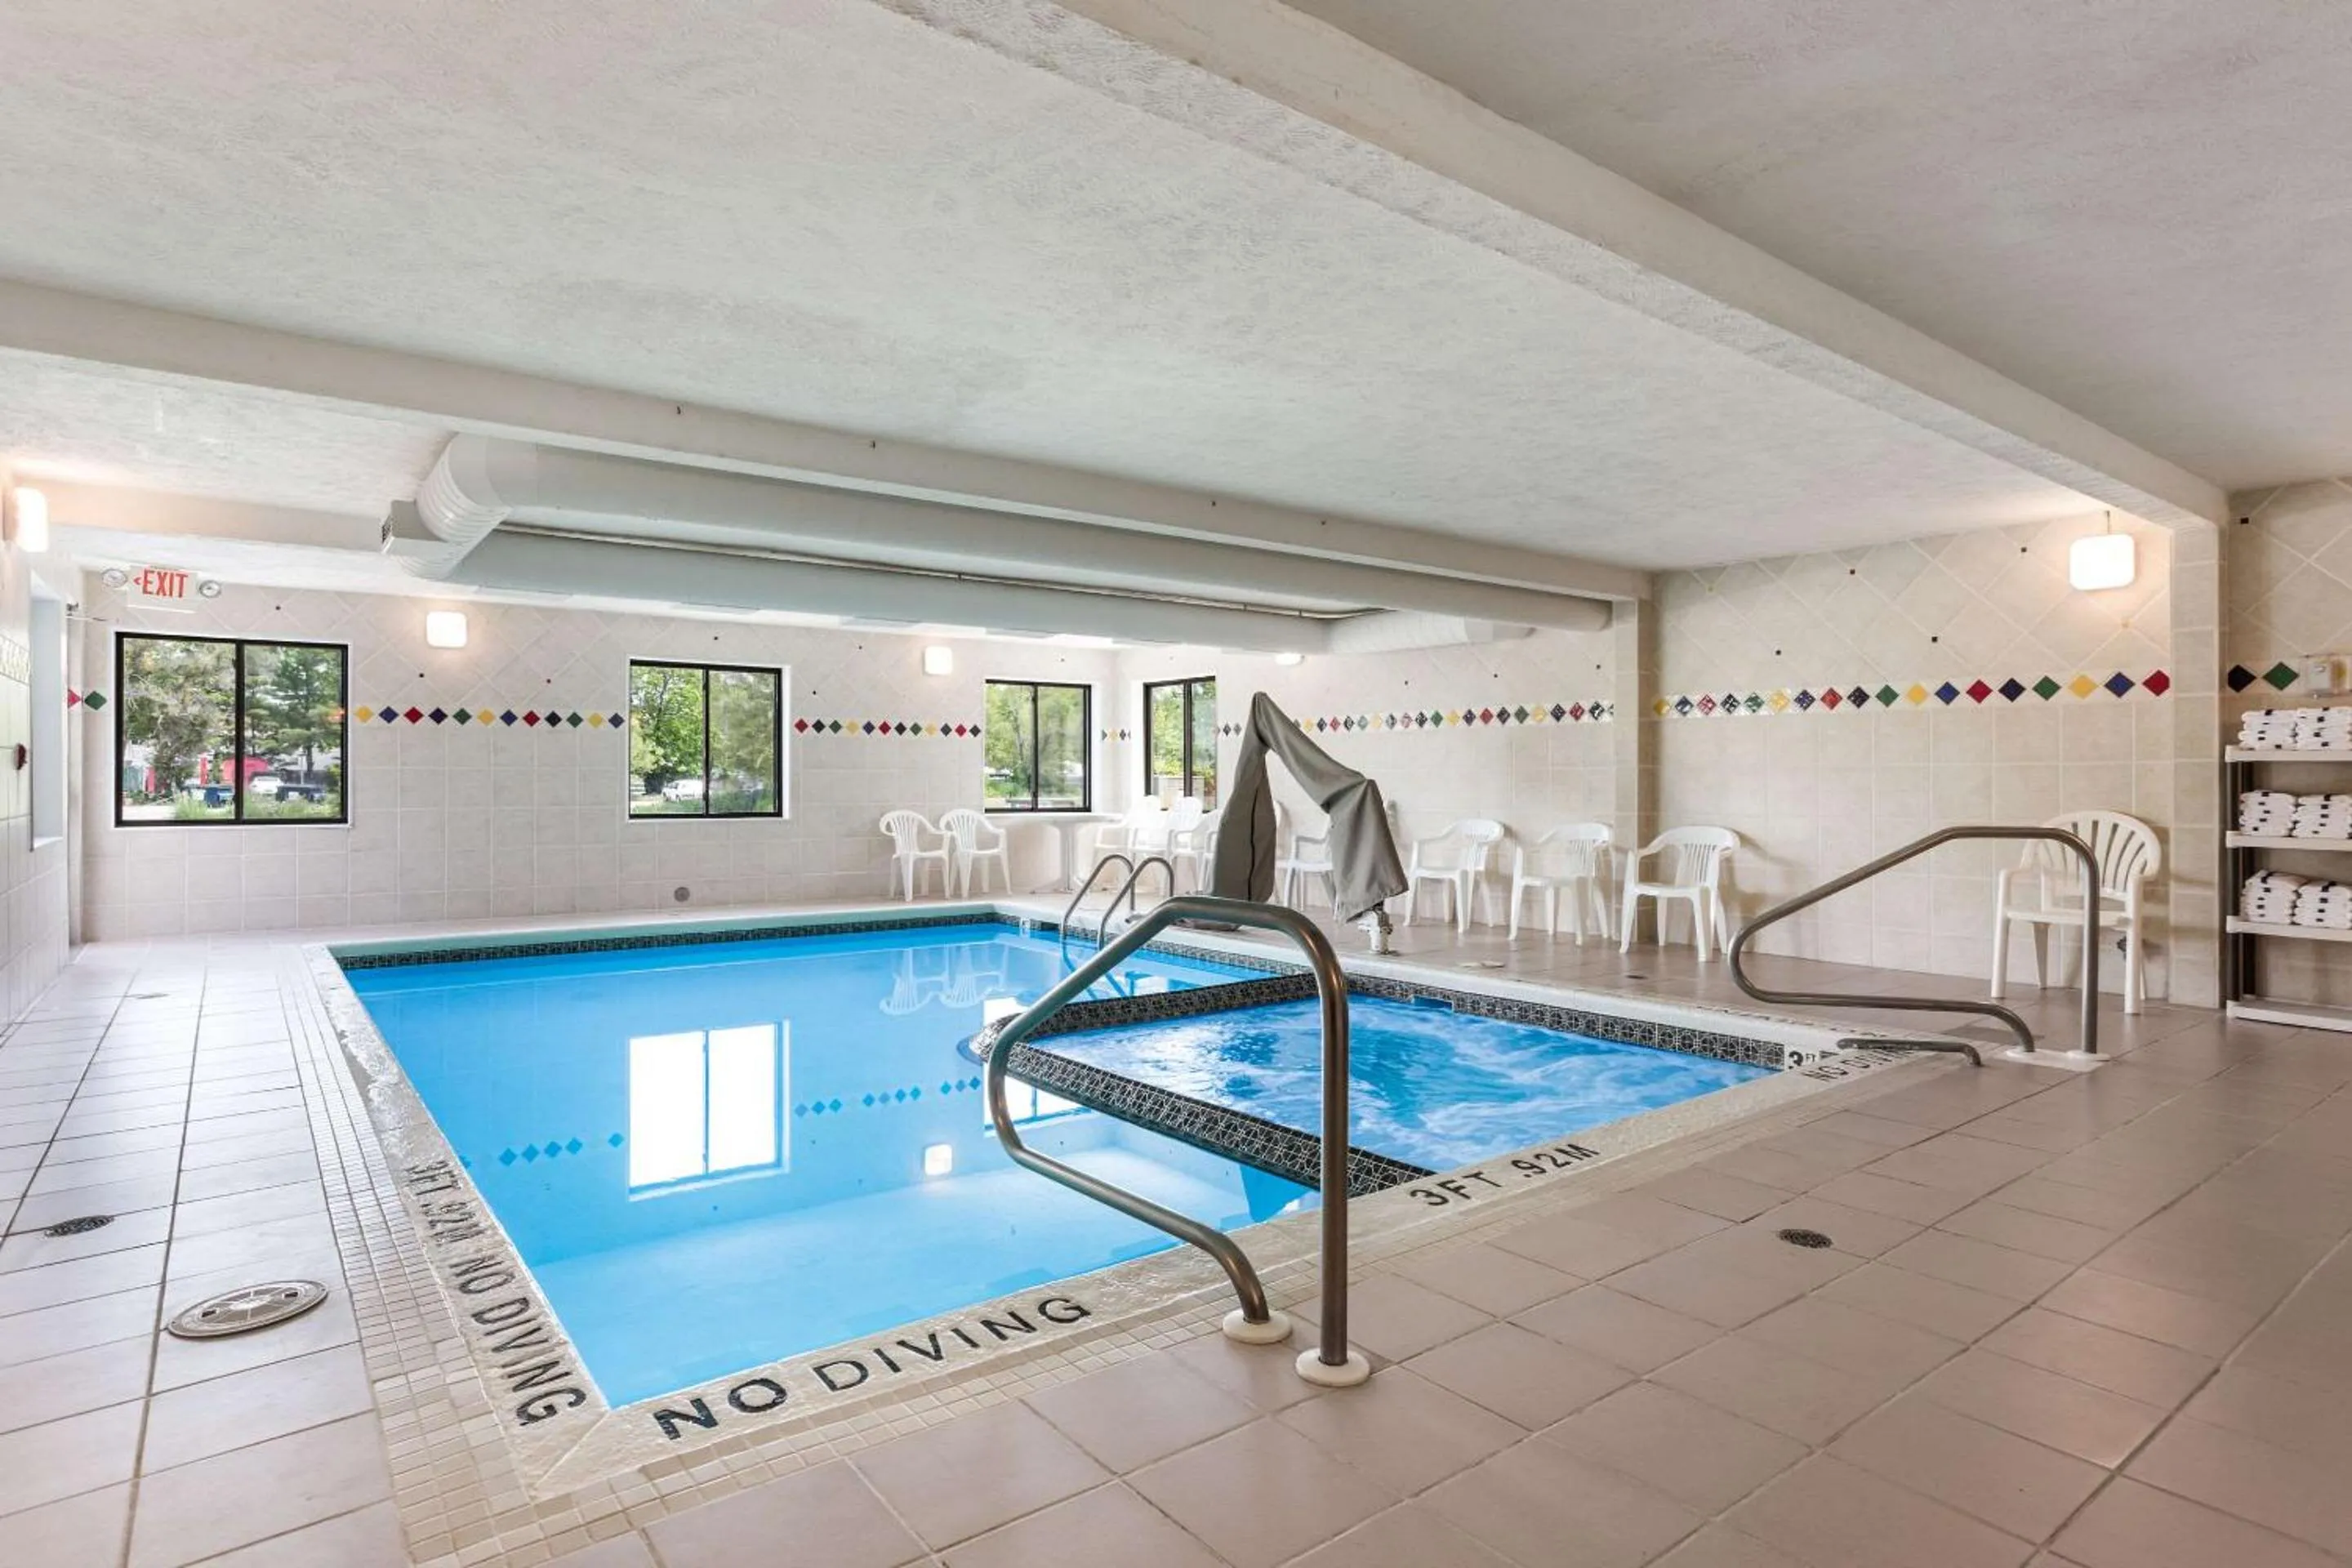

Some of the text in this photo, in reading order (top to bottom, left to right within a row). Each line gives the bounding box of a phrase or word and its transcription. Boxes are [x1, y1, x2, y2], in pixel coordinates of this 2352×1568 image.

[142, 568, 189, 598] EXIT
[1802, 1065, 1849, 1083] NO
[1410, 1143, 1600, 1206] 3FT .92M
[449, 1254, 515, 1294] NO
[471, 1297, 587, 1427] DIVING
[653, 1297, 1092, 1441] NO DIVING
